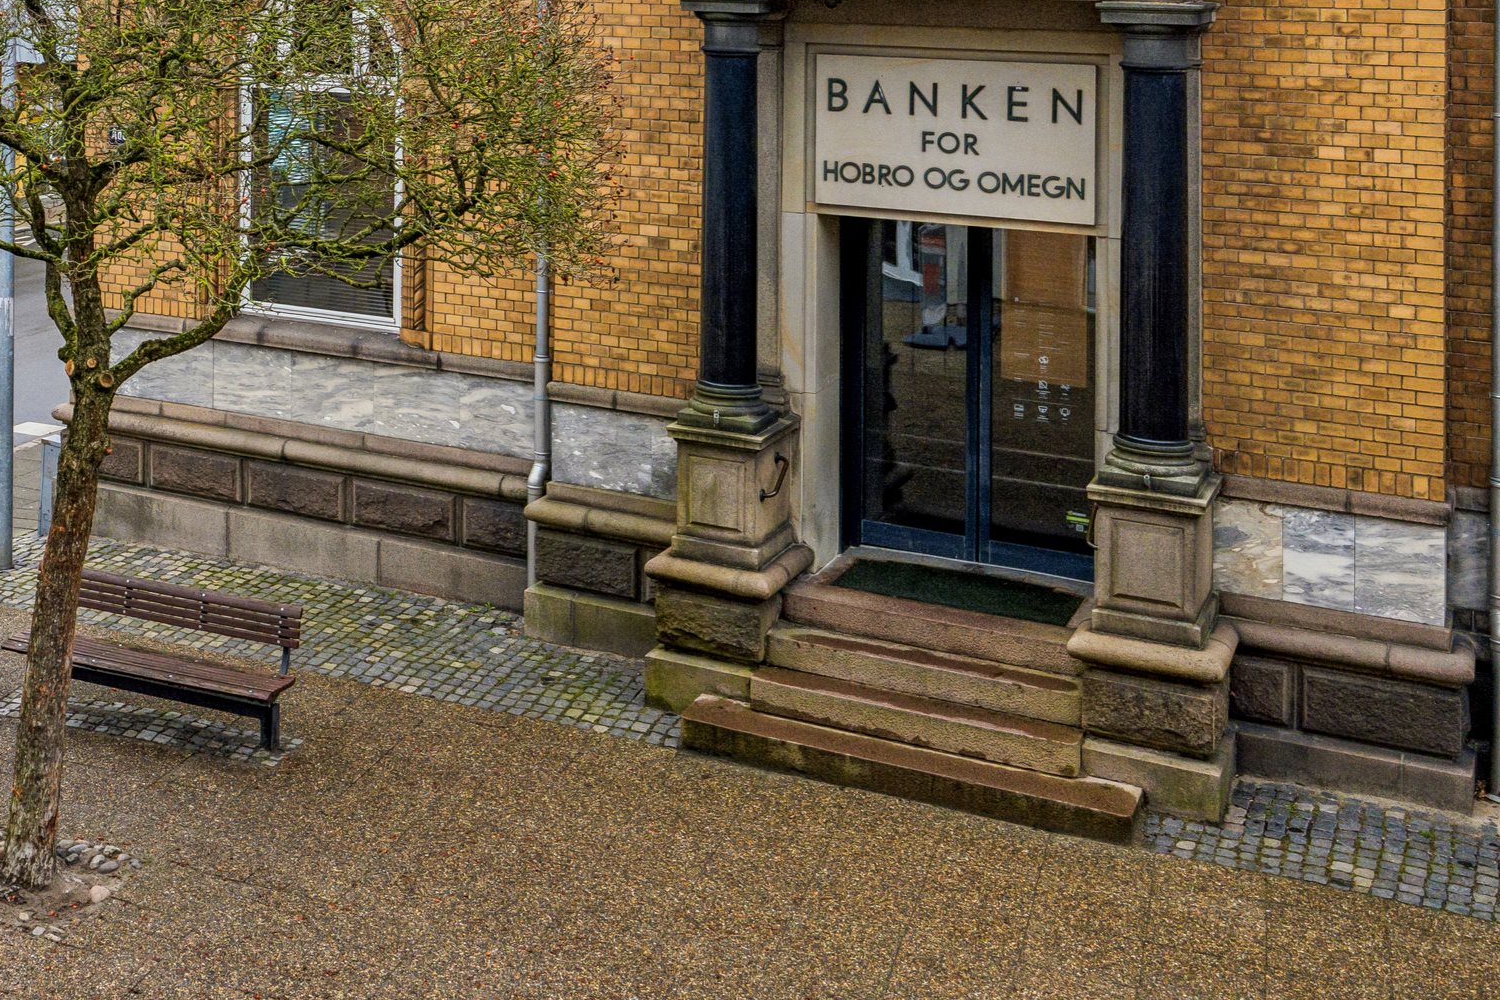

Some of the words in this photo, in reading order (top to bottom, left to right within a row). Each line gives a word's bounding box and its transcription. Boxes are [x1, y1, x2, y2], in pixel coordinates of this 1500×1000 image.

[827, 78, 1083, 125] BANKEN
[921, 131, 980, 156] FOR
[823, 160, 914, 187] HOBRO
[923, 167, 970, 191] OG
[977, 171, 1085, 200] OMEGN
